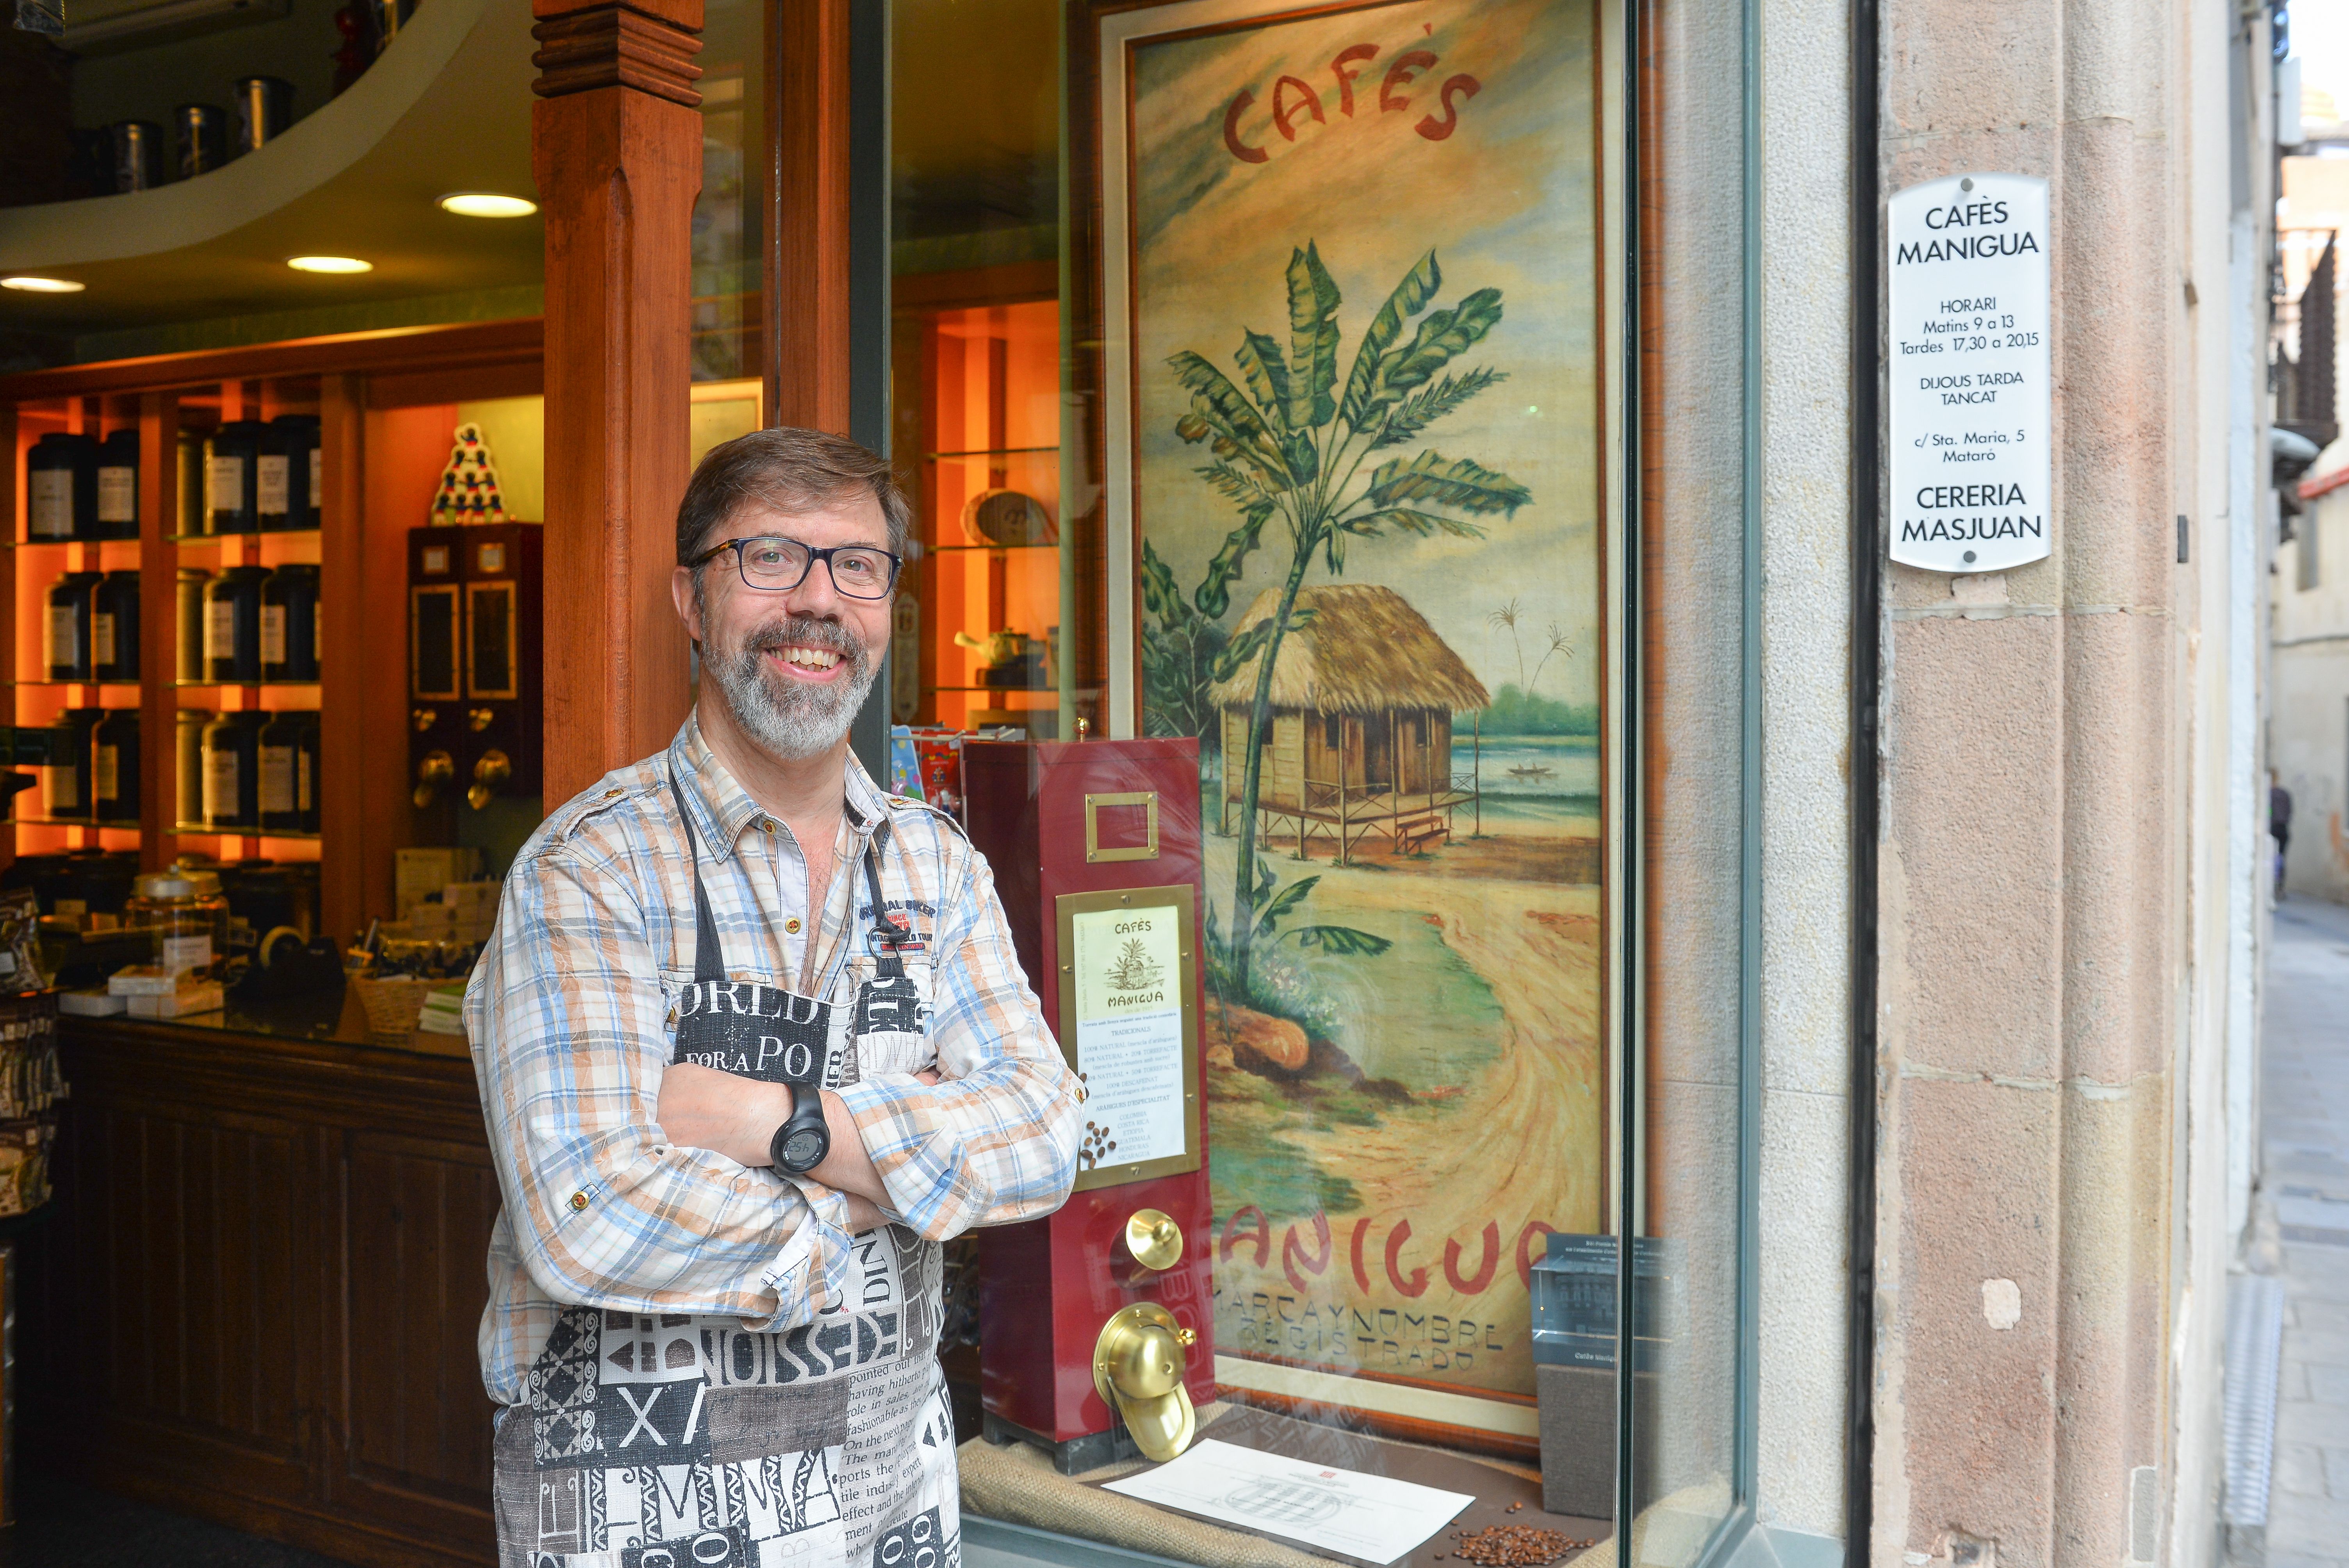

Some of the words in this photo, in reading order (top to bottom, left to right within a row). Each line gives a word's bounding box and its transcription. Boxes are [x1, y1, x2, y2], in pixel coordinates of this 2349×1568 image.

[1925, 195, 2009, 229] CAFÈS
[1897, 232, 2039, 265] MANIGUA
[1941, 297, 1996, 313] HORARI
[1924, 319, 1969, 334] Matins
[1974, 317, 1983, 330] 9
[1988, 320, 1996, 329] a
[2001, 315, 2014, 328] 13
[1900, 339, 1943, 355] Tardes
[1953, 336, 1986, 353] 17,30
[1992, 339, 2001, 348] a
[2007, 332, 2039, 349] 20,15
[1920, 375, 1971, 390] DIJOUS
[1977, 371, 2024, 385] TARDA
[1941, 390, 1997, 405] TANCAT
[1914, 433, 1928, 448] c/
[1932, 434, 1957, 446] Sta.
[1964, 431, 2010, 445] Maria,
[2016, 429, 2025, 442] 5
[1943, 448, 1996, 463] Mataró
[1916, 483, 2026, 509] CERERIA
[1902, 515, 2041, 542] MASJUAN
[905, 900, 936, 918] BIKER
[918, 933, 932, 942] TOUR
[1108, 991, 1164, 1008] MANIGUA
[1111, 1026, 1151, 1036] TRADICIONALS
[685, 1051, 729, 1070] FOR
[730, 1053, 750, 1072] A
[1097, 1053, 1124, 1062] NATURAL
[1097, 1071, 1124, 1080] NATURAL
[849, 1365, 889, 1388] pointed
[895, 1358, 910, 1372] out
[848, 1384, 885, 1401] having
[889, 1371, 921, 1390] hitherto
[846, 1404, 866, 1419] role
[871, 1400, 881, 1410] in
[886, 1392, 910, 1406] sales,
[899, 1406, 908, 1414] as
[843, 1440, 862, 1451] On
[866, 1434, 882, 1447] the
[883, 1425, 899, 1442] next
[839, 1468, 871, 1489] ports
[877, 1463, 894, 1476] the
[841, 1488, 859, 1503] tile
[902, 1457, 921, 1478] expert
[842, 1504, 874, 1522] effect
[877, 1495, 892, 1513] and
[893, 1488, 904, 1503] the
[845, 1523, 872, 1541] ment
